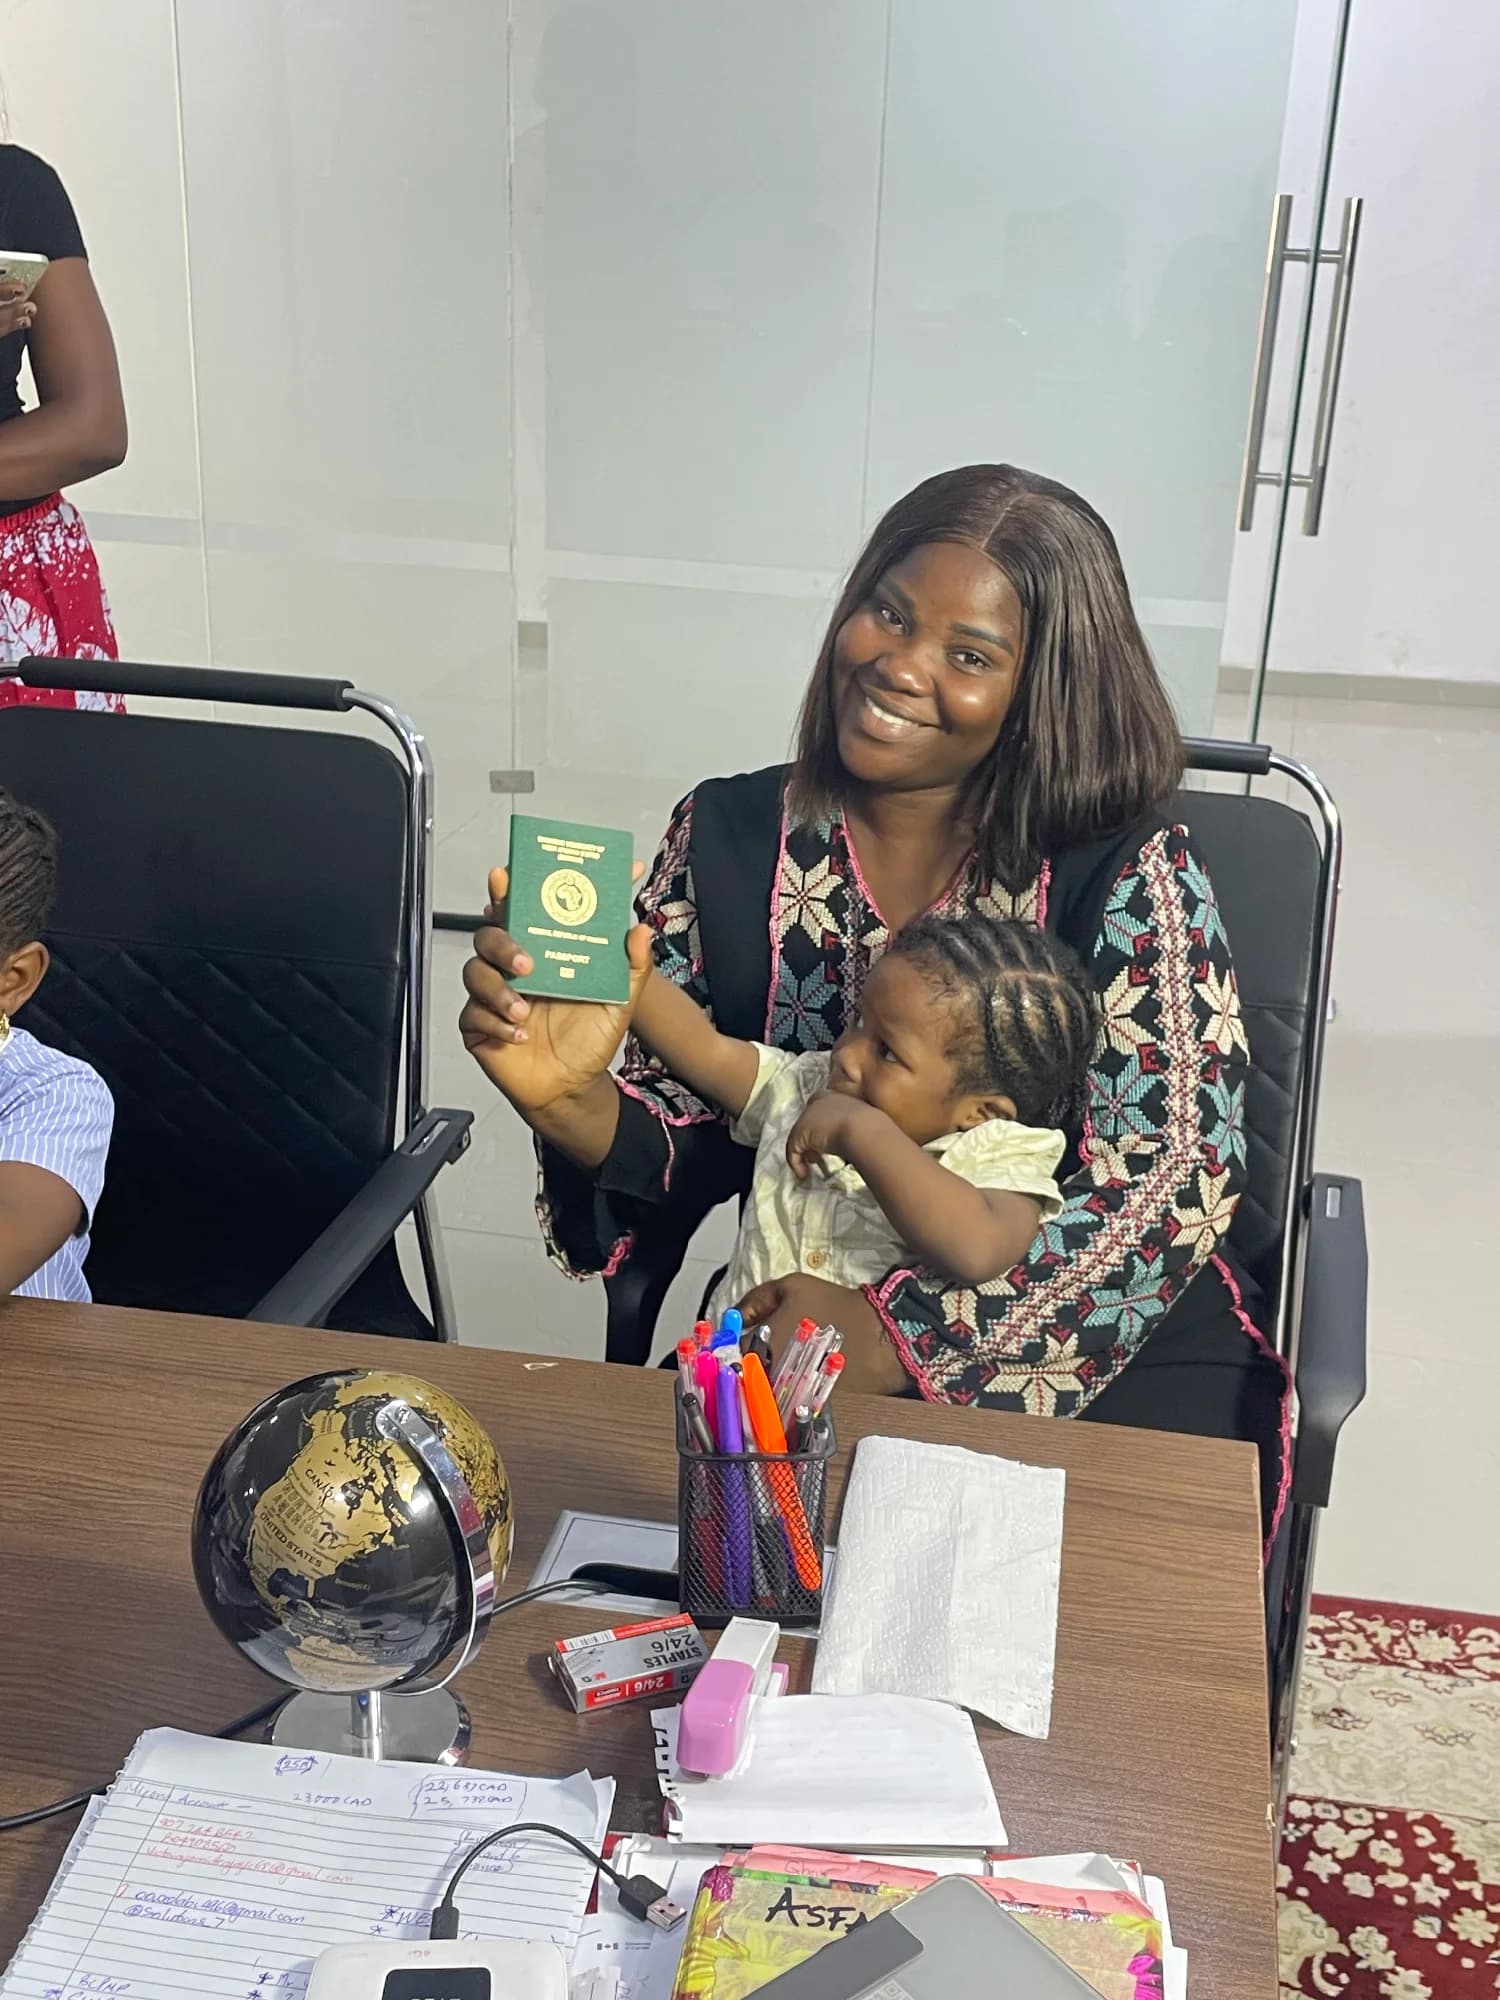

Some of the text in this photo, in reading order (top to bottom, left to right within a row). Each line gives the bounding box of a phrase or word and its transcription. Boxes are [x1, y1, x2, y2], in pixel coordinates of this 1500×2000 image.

[305, 1468, 336, 1505] CANAD
[260, 1512, 322, 1568] UNITED STATES
[651, 1634, 697, 1653] 24/6
[643, 1646, 703, 1669] STAPLES
[634, 1676, 665, 1693] 24/6
